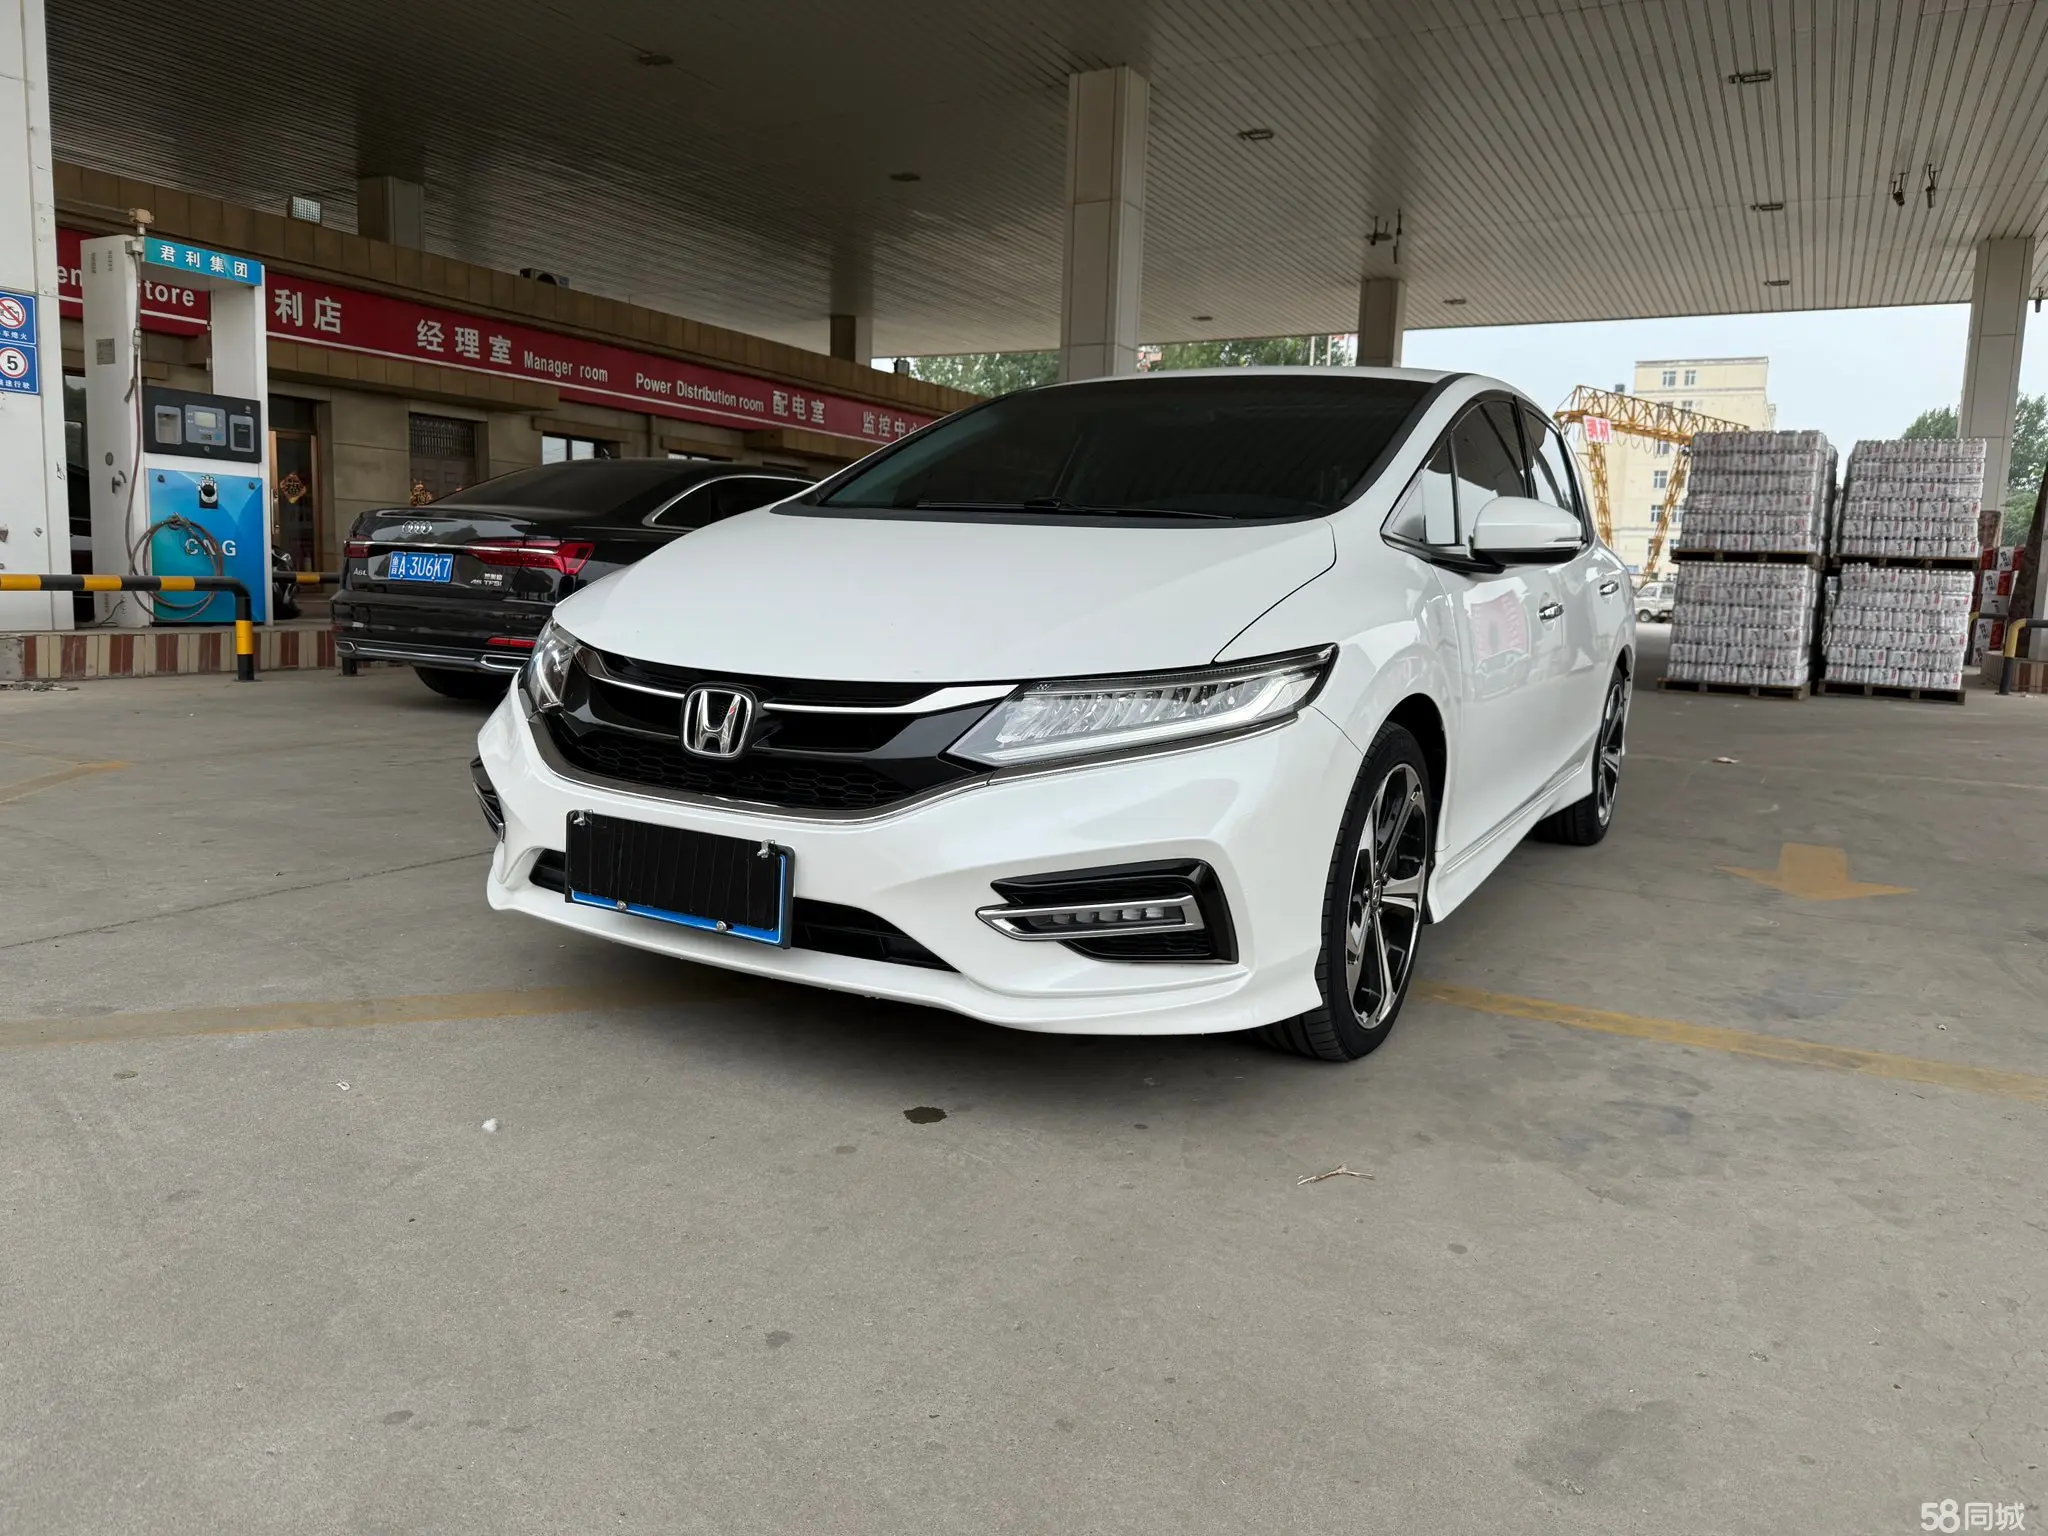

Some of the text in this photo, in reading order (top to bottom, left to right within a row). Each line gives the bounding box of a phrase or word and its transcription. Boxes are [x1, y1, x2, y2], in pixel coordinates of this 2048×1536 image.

[160, 245, 248, 278] 君利集团
[137, 278, 195, 307] tore
[274, 289, 342, 333] 利店
[0, 330, 28, 341] 车熄火
[416, 319, 512, 365] 经理室
[7, 355, 19, 371] 5
[524, 350, 609, 382] Manager room
[636, 372, 765, 413] Power Distribution room
[772, 390, 825, 424] 配电室
